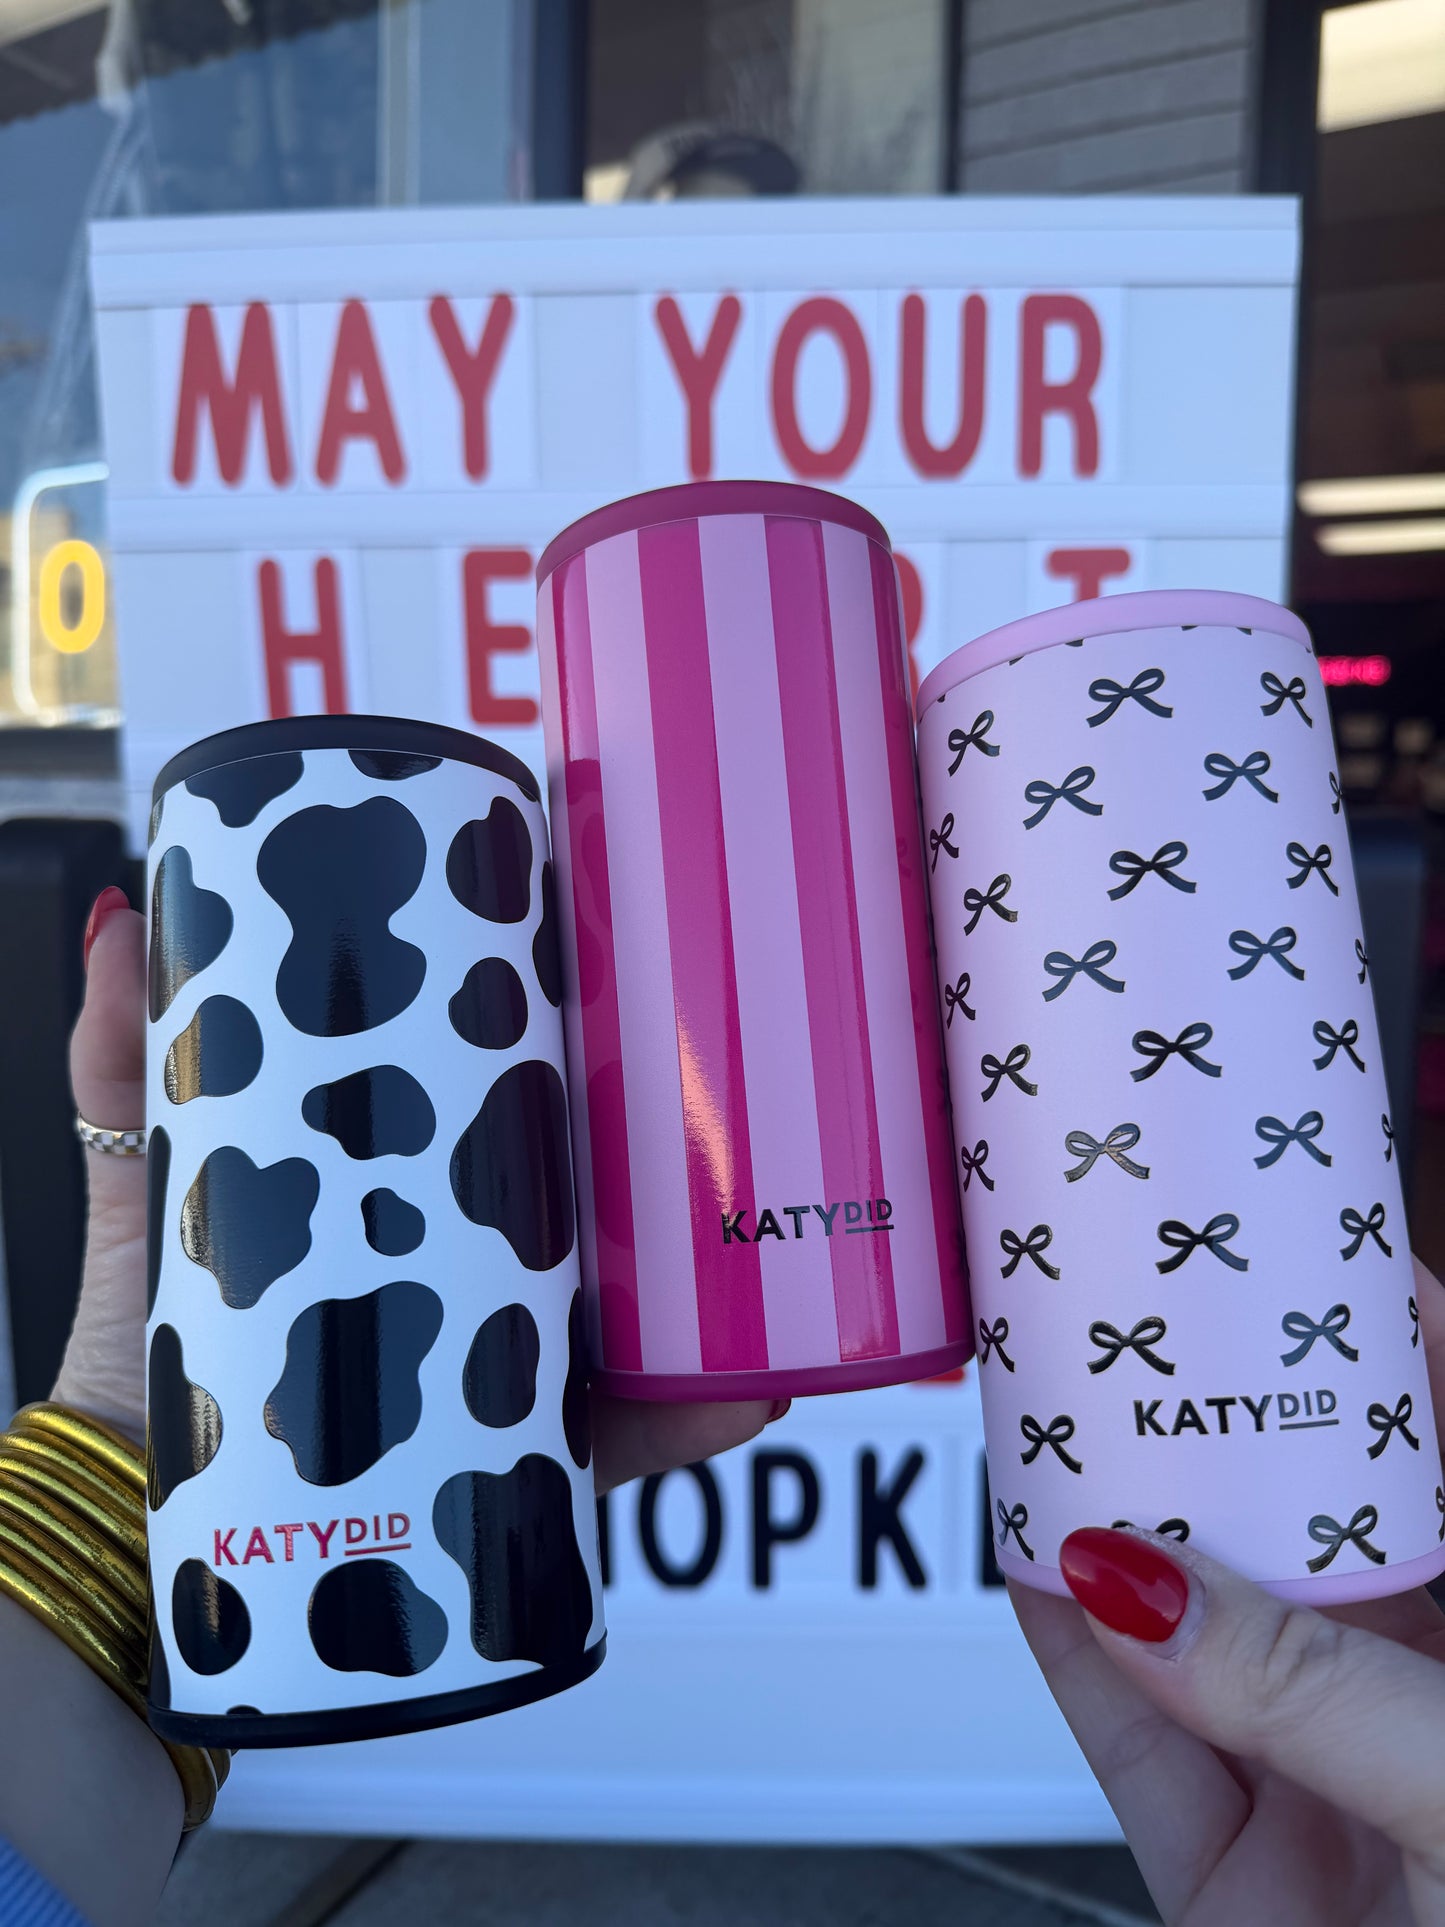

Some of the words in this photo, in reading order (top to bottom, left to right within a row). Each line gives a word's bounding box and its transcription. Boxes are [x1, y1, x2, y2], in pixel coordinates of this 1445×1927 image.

[171, 291, 516, 488] MAY
[654, 289, 1105, 482] YOUR
[721, 1199, 894, 1244] KATYDID
[1133, 1389, 1340, 1436] KATYDID
[213, 1512, 412, 1566] KATYDID
